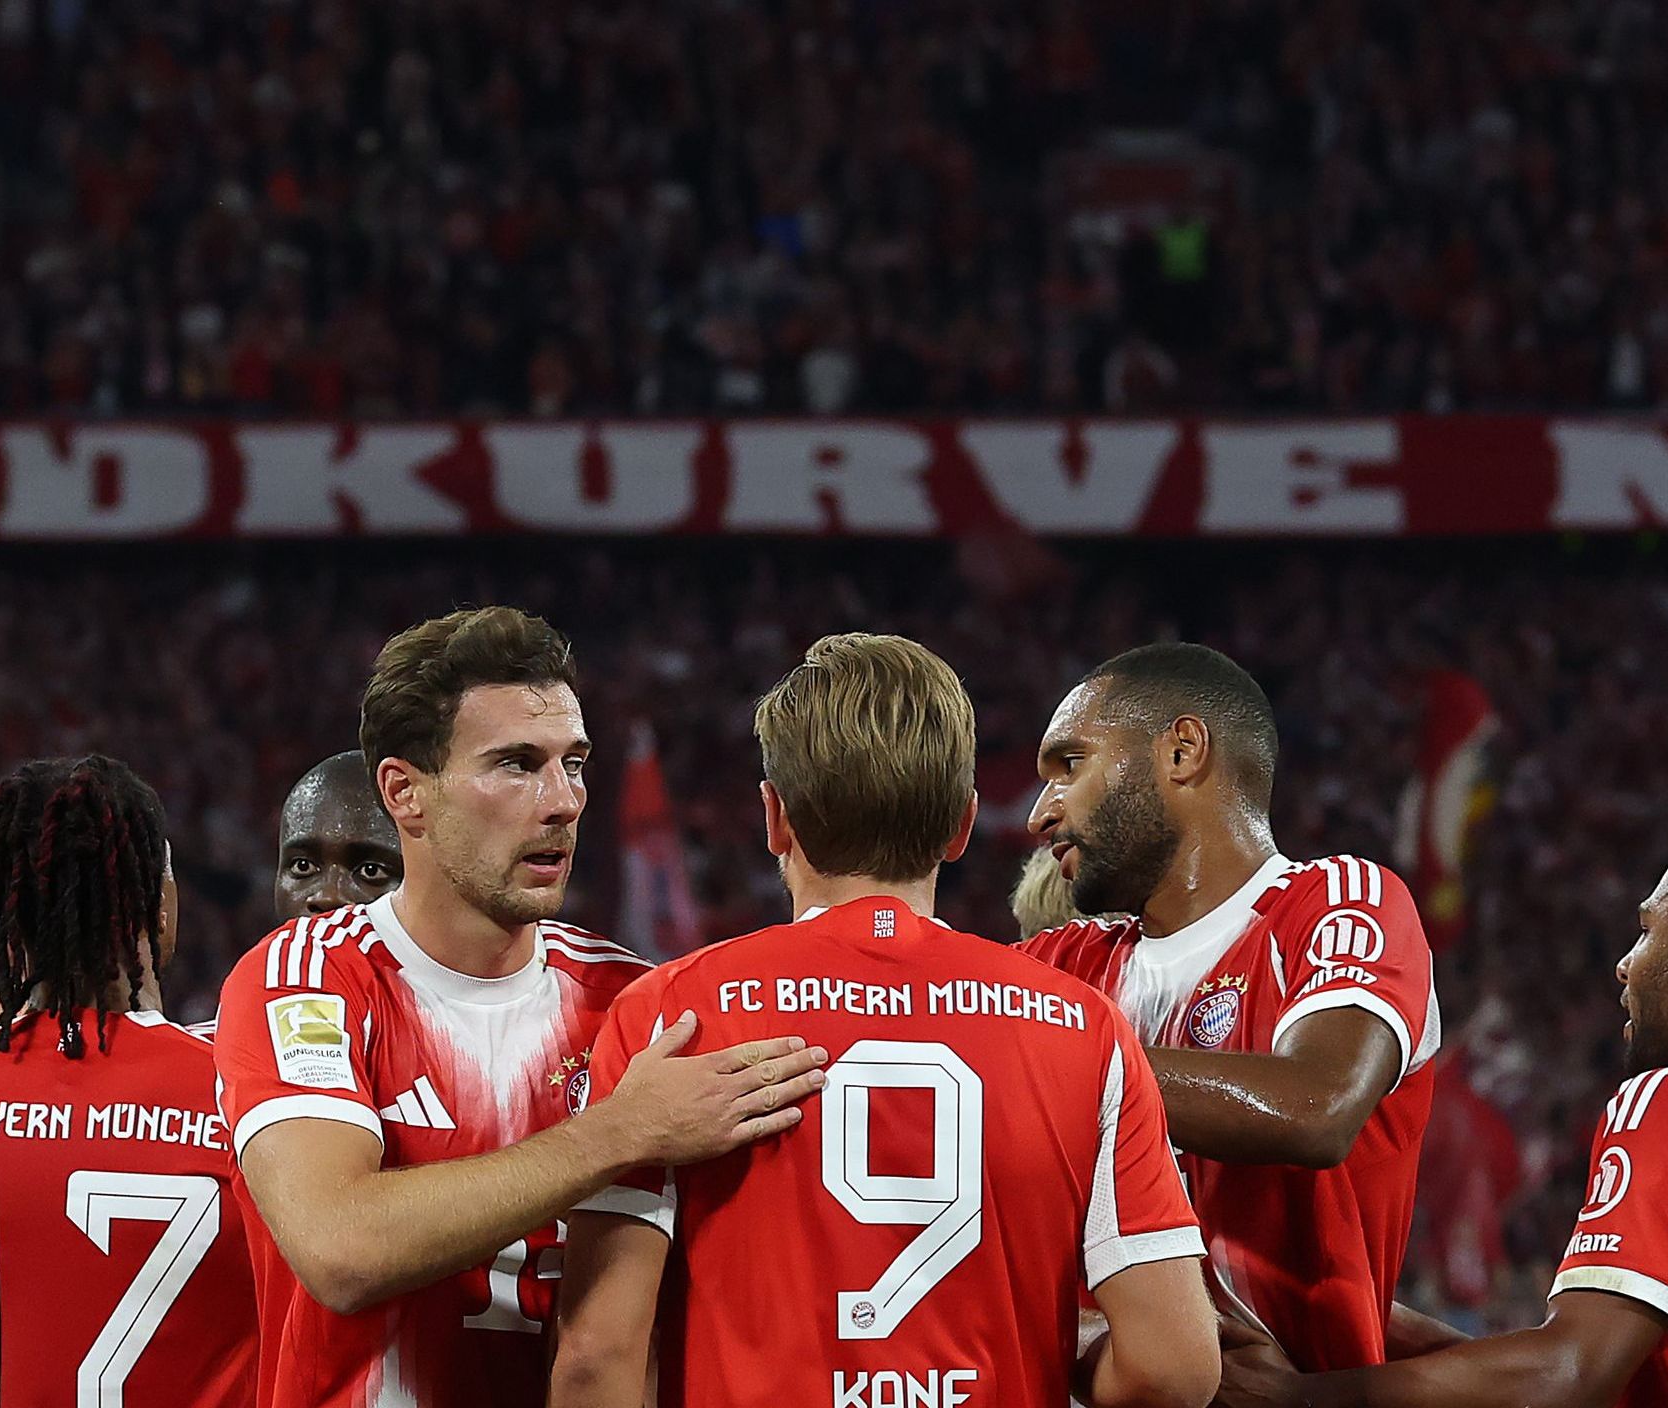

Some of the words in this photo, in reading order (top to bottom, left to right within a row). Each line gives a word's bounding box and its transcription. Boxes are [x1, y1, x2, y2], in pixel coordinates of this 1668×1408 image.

[873, 909, 895, 920] MIA
[873, 919, 895, 930] SAN
[873, 928, 894, 938] MIA
[719, 978, 762, 1013] FC
[775, 977, 913, 1016] BAYERN
[927, 978, 1085, 1031] MÜNCHEN
[283, 1047, 343, 1061] BUNDESLIGA
[85, 1103, 229, 1151] MÜNCHE
[821, 1039, 983, 1340] 9
